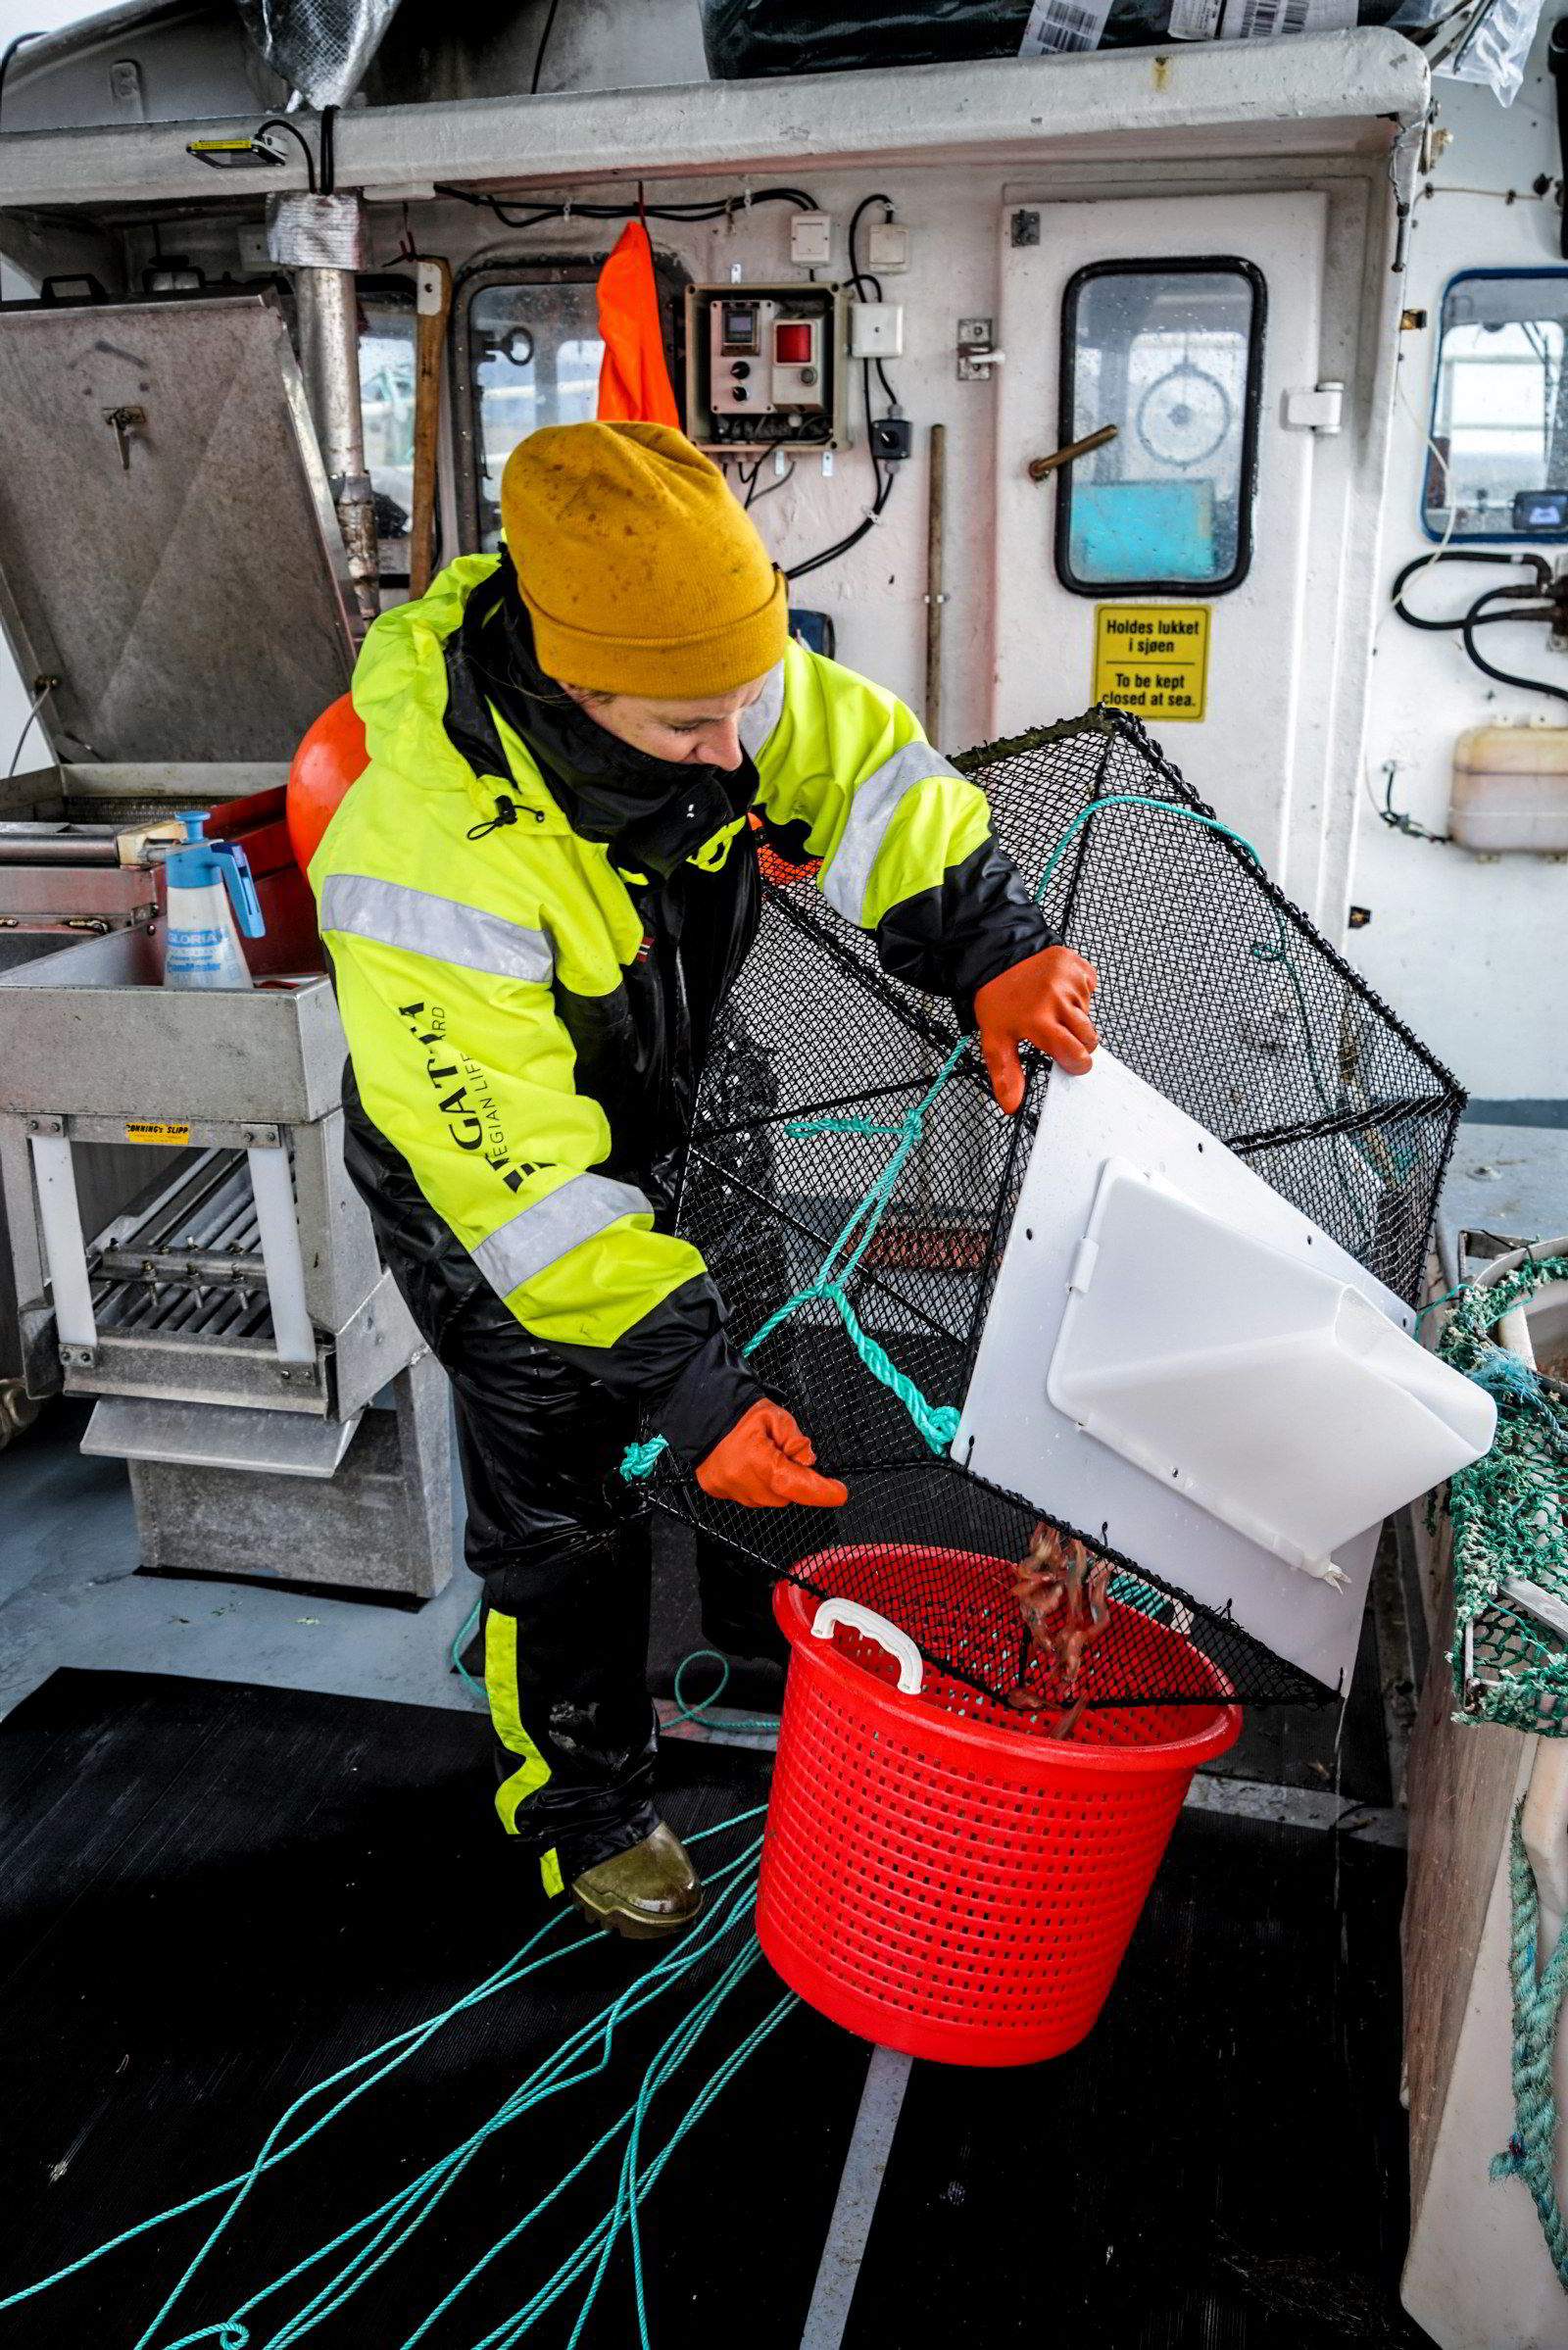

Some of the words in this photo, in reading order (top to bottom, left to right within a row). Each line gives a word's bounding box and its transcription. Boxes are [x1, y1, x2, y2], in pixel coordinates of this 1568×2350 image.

[1106, 619, 1153, 635] Holdes
[1158, 620, 1200, 635] lukket
[1129, 638, 1133, 652] i
[1137, 638, 1174, 656] sjøen
[1115, 673, 1130, 687] To
[1135, 673, 1151, 688] be
[1155, 674, 1185, 691] kept
[1102, 692, 1146, 706] closed
[1151, 693, 1163, 706] at
[1167, 695, 1196, 707] sea.
